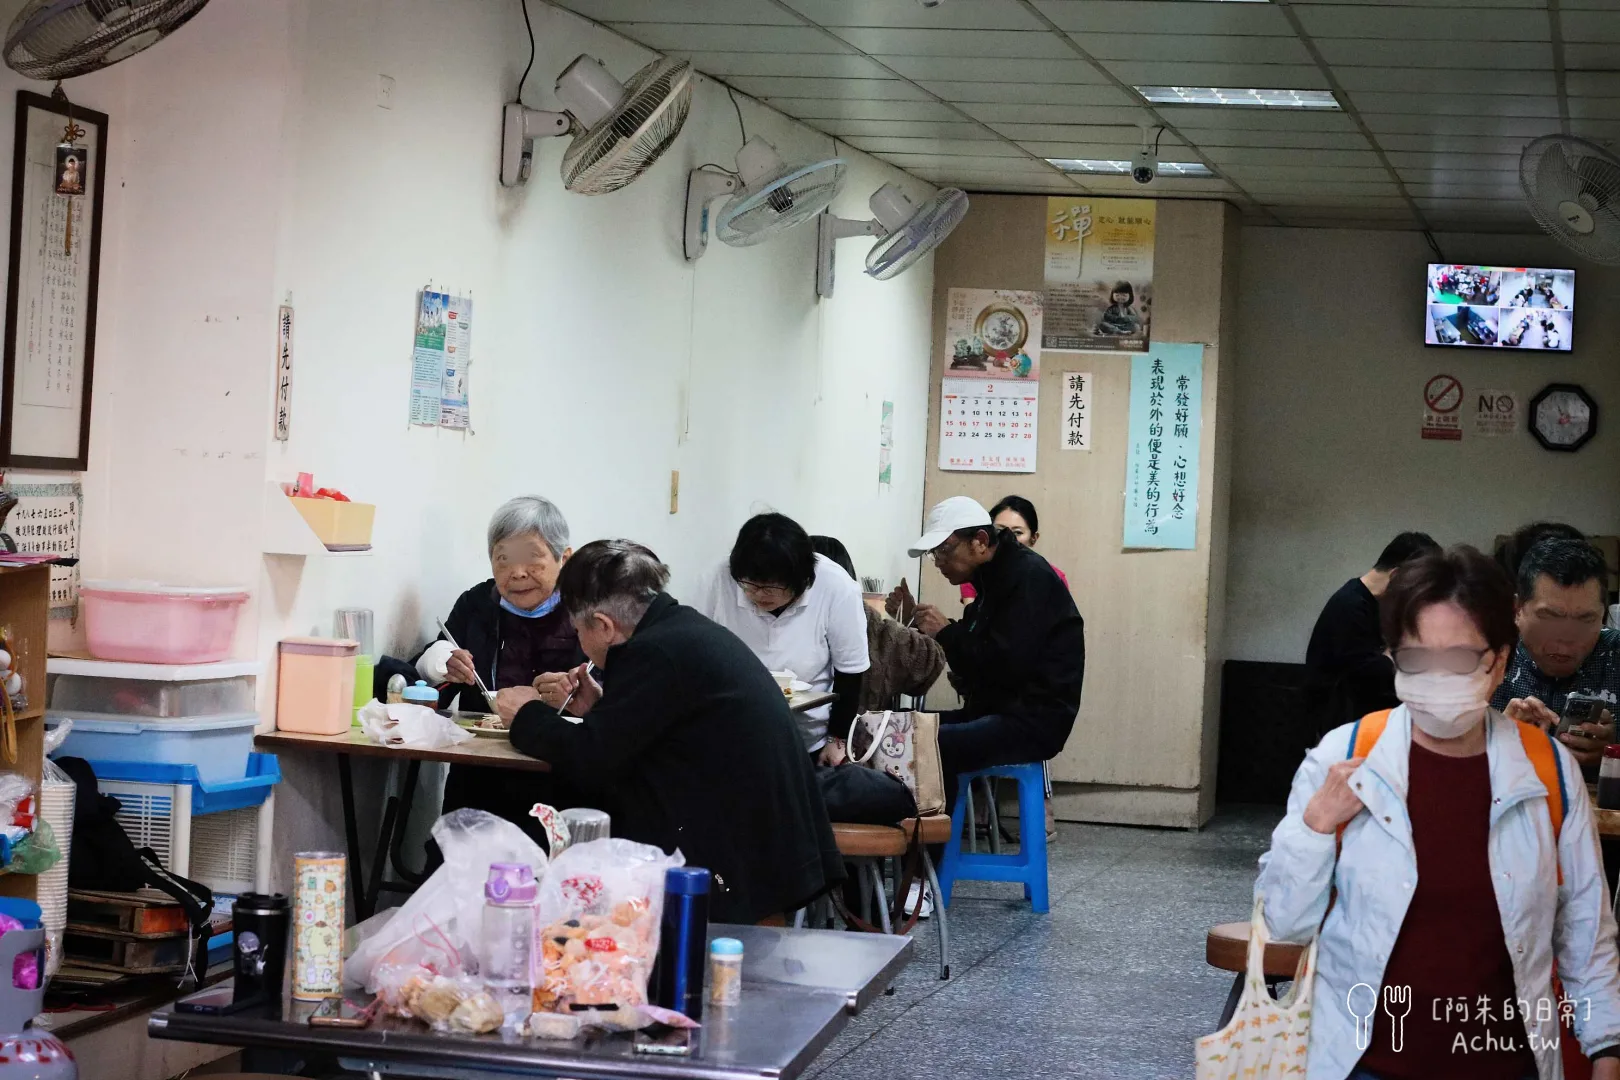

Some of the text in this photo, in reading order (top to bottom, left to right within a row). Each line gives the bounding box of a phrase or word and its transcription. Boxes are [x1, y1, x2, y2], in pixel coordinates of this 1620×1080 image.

[1051, 204, 1092, 279] 禪
[278, 312, 290, 431] 請先付款
[987, 384, 993, 393] 2
[1068, 375, 1085, 445] 請先付款
